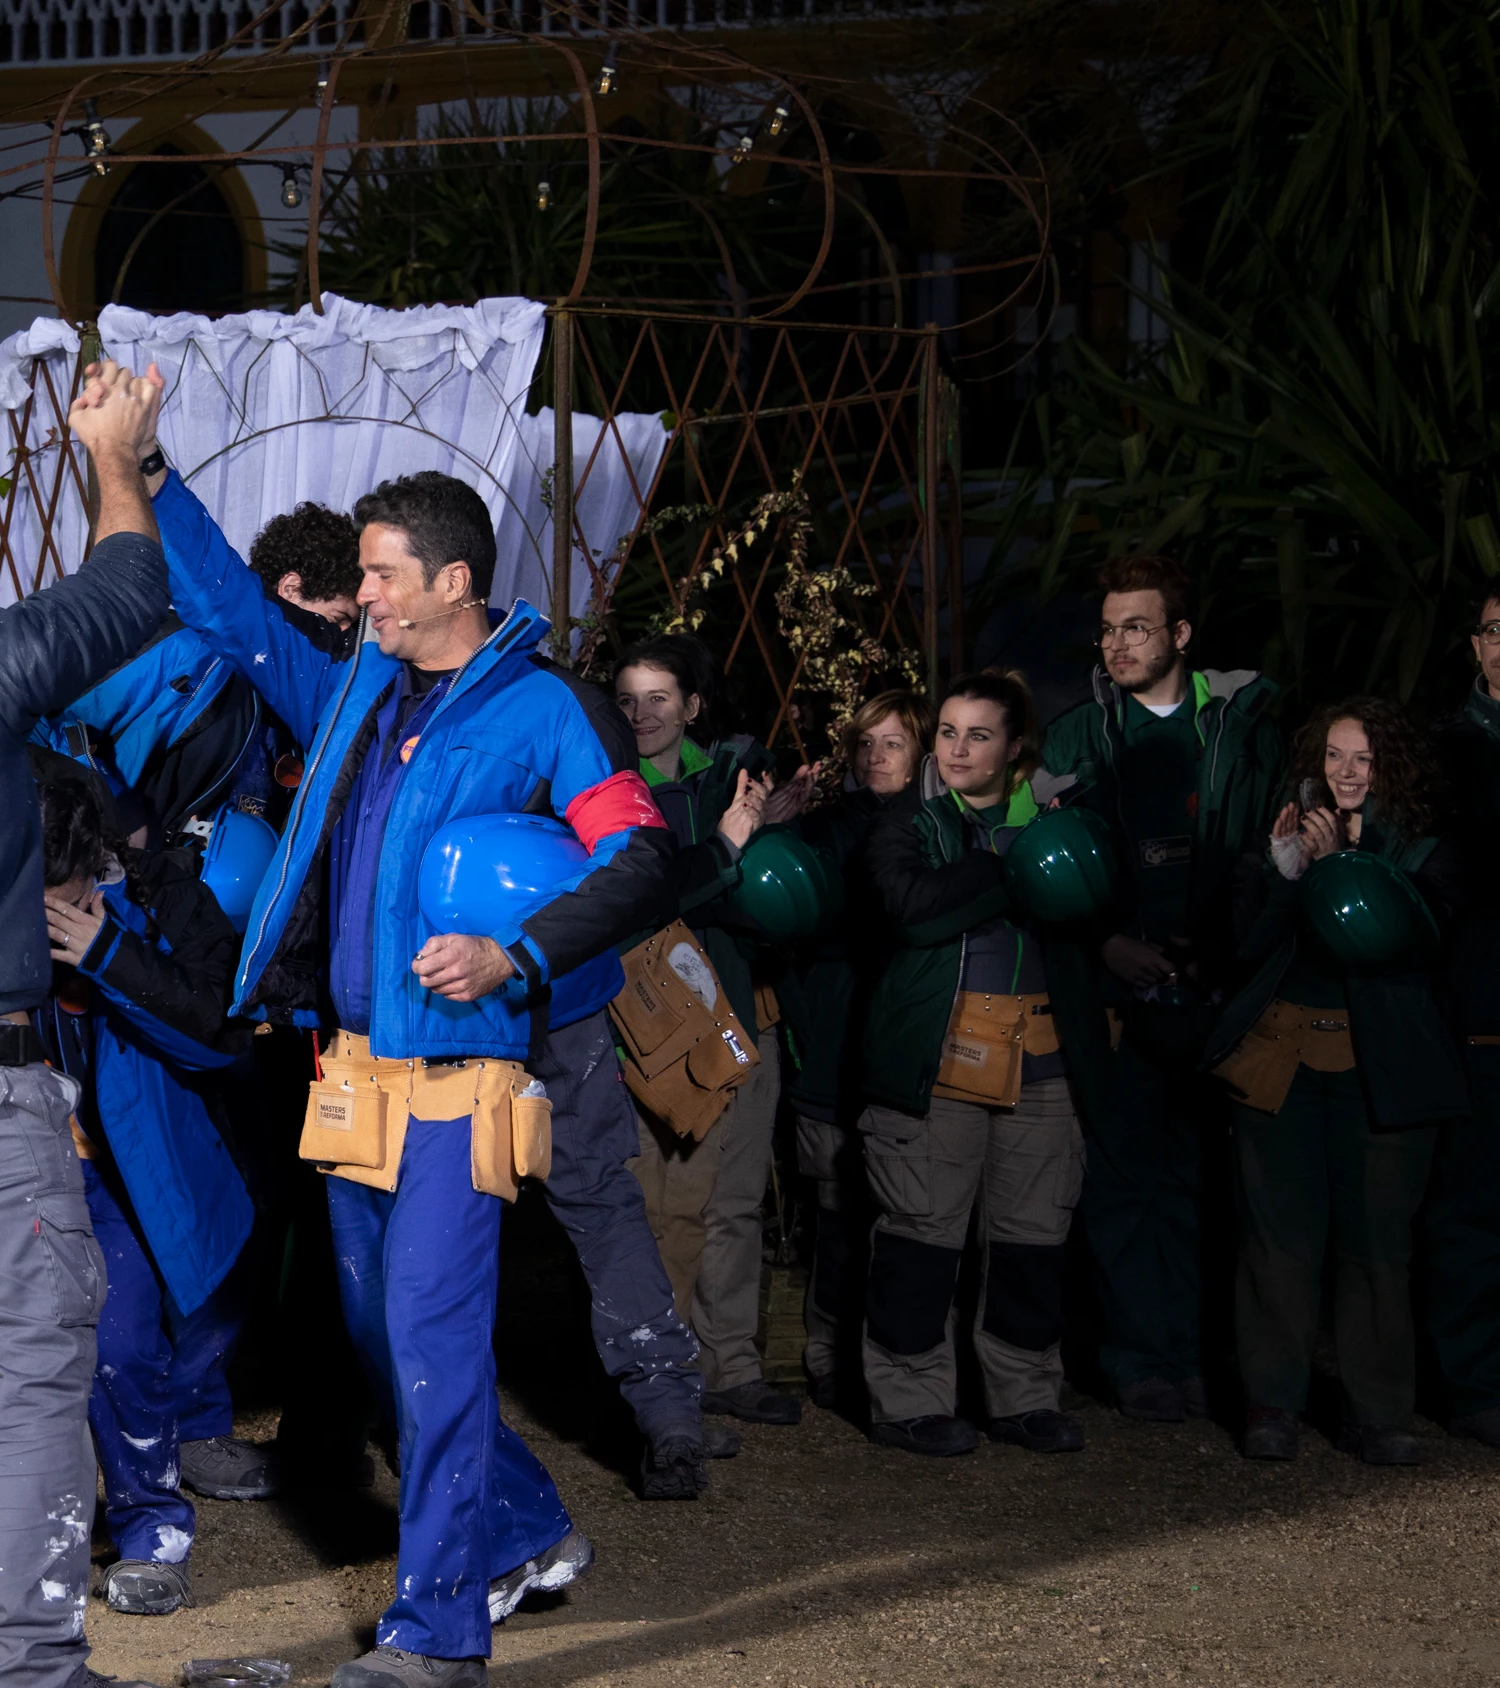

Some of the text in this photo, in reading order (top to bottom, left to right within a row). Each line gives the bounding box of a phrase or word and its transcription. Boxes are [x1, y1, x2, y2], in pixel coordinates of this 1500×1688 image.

[637, 980, 656, 1009] MASTERS
[950, 1043, 981, 1056] MASTERS
[320, 1104, 345, 1114] MASTERS
[323, 1112, 345, 1121] REFORMA
